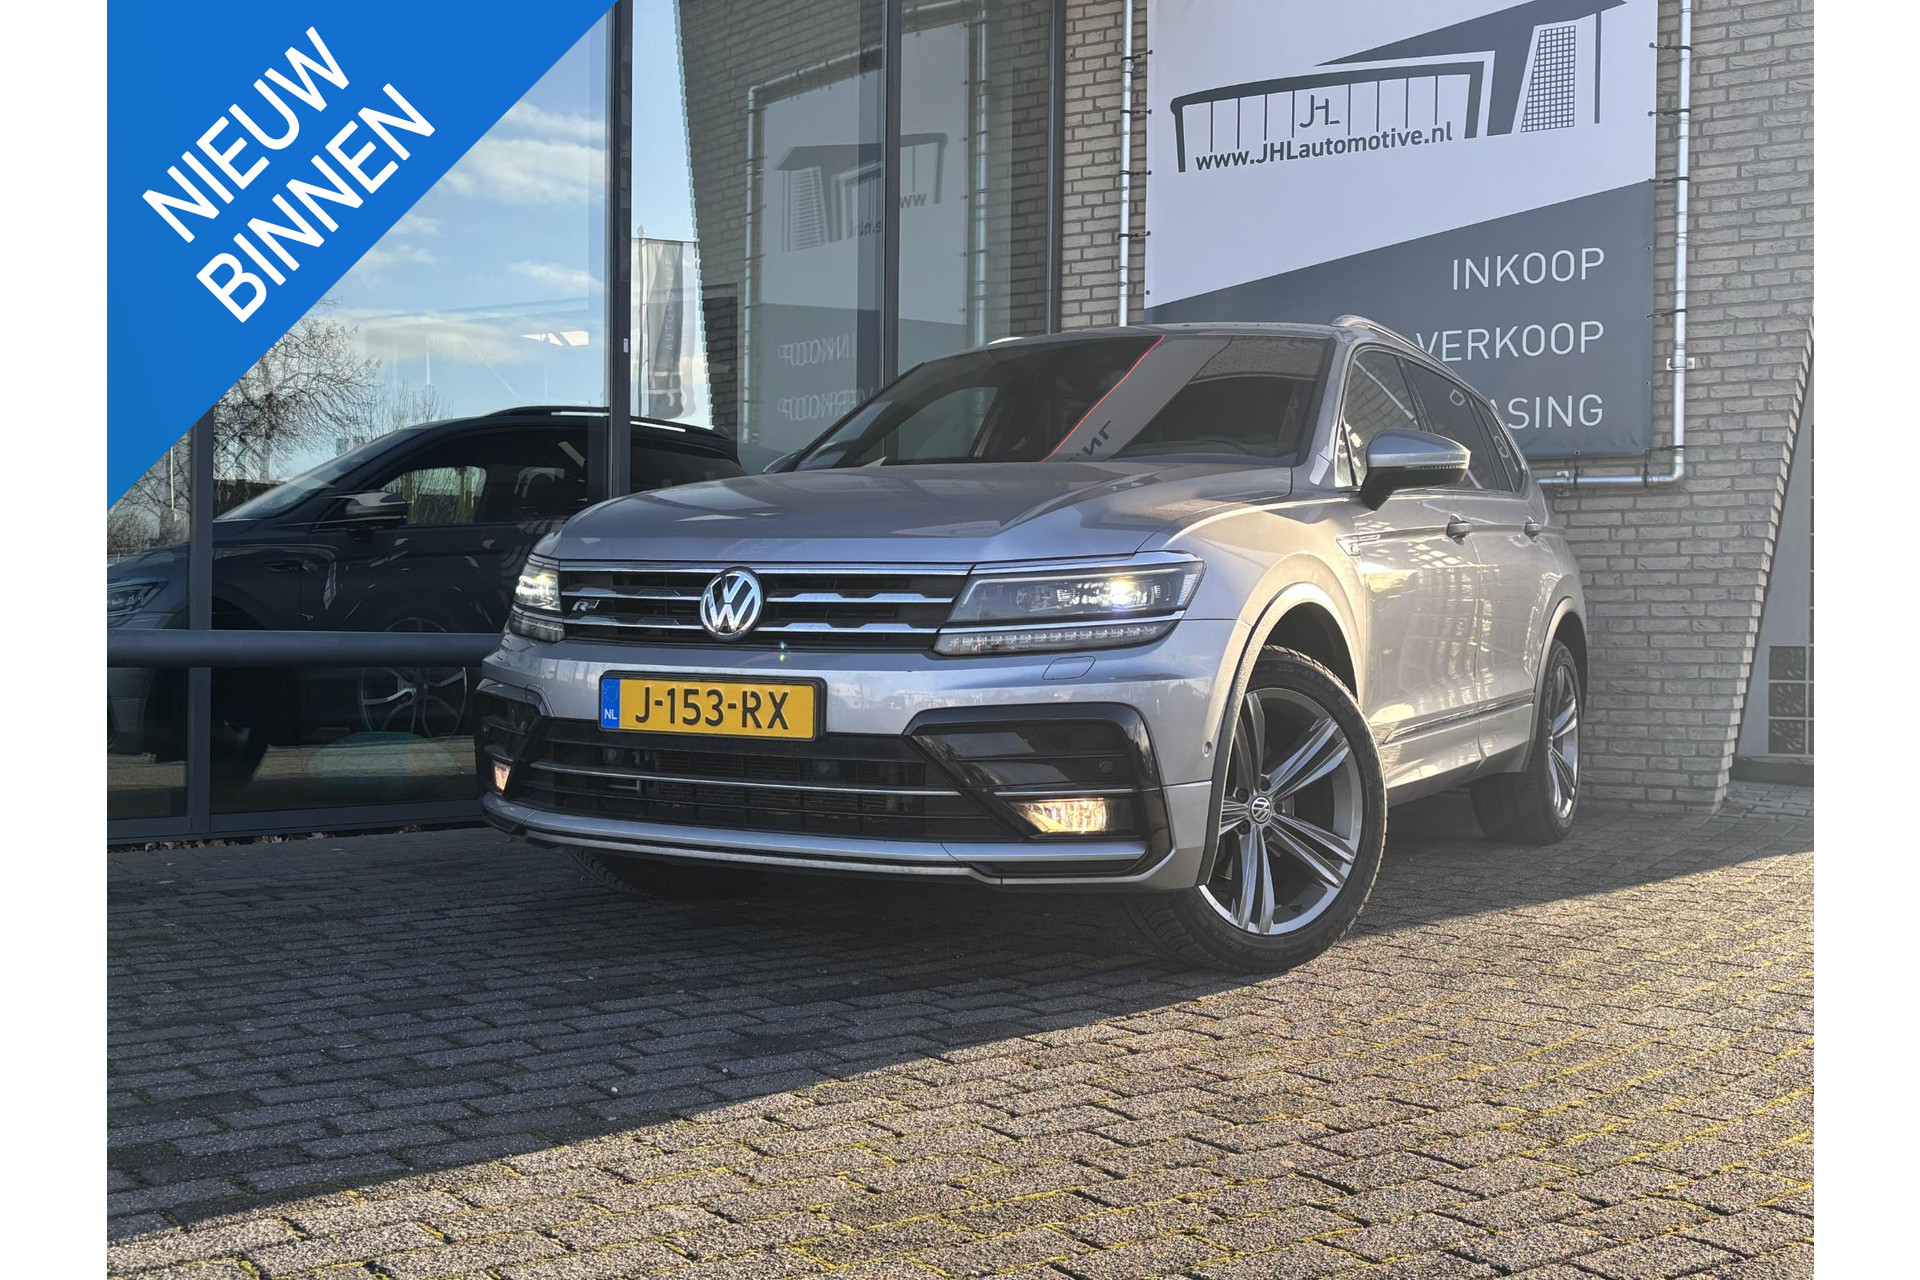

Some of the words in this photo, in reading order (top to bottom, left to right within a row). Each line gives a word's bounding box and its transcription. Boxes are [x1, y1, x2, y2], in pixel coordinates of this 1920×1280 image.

[1195, 121, 1453, 171] www.JHLautomotive.nl
[1452, 246, 1606, 292] INKOOP
[1415, 320, 1605, 363] VERKOOP
[604, 709, 618, 720] NL
[635, 686, 789, 730] J-153-RX
